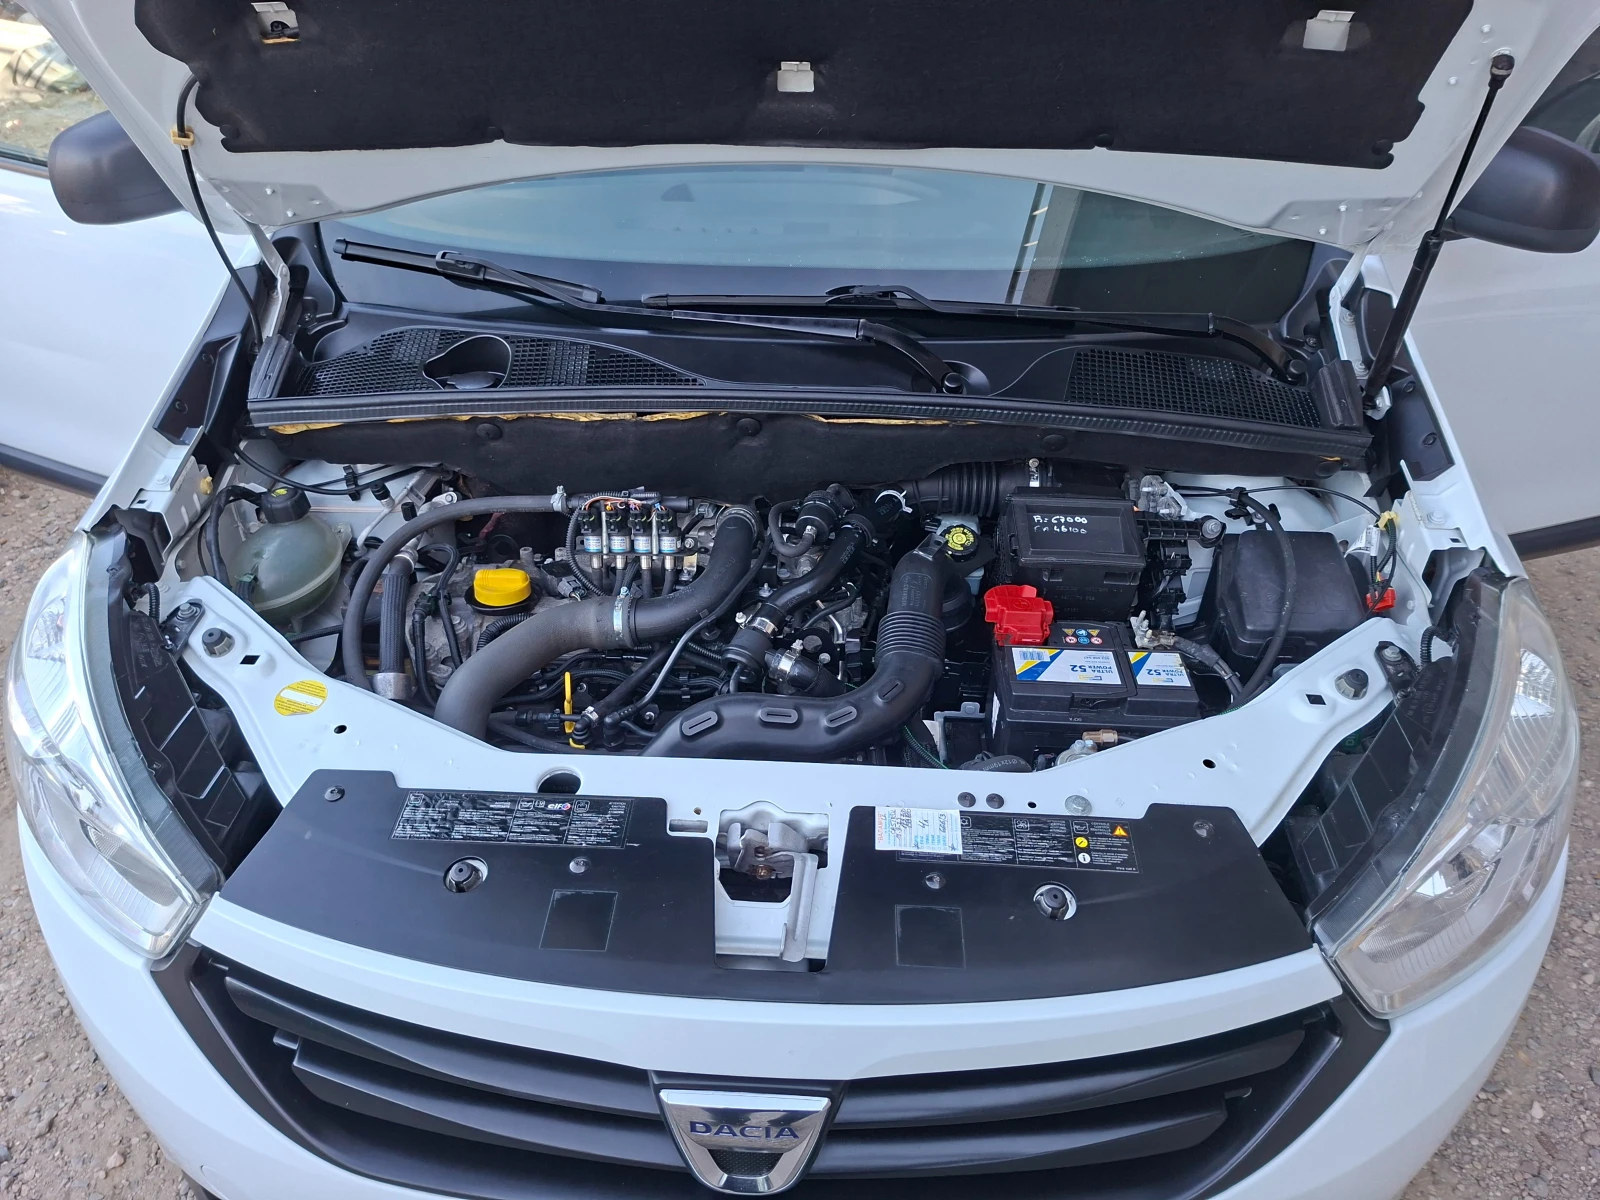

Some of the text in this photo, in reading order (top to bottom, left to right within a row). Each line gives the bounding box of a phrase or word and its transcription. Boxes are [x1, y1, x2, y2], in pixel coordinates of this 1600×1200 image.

[1069, 664, 1087, 673] 52
[1145, 668, 1161, 676] 52
[689, 1120, 800, 1140] DACIA
